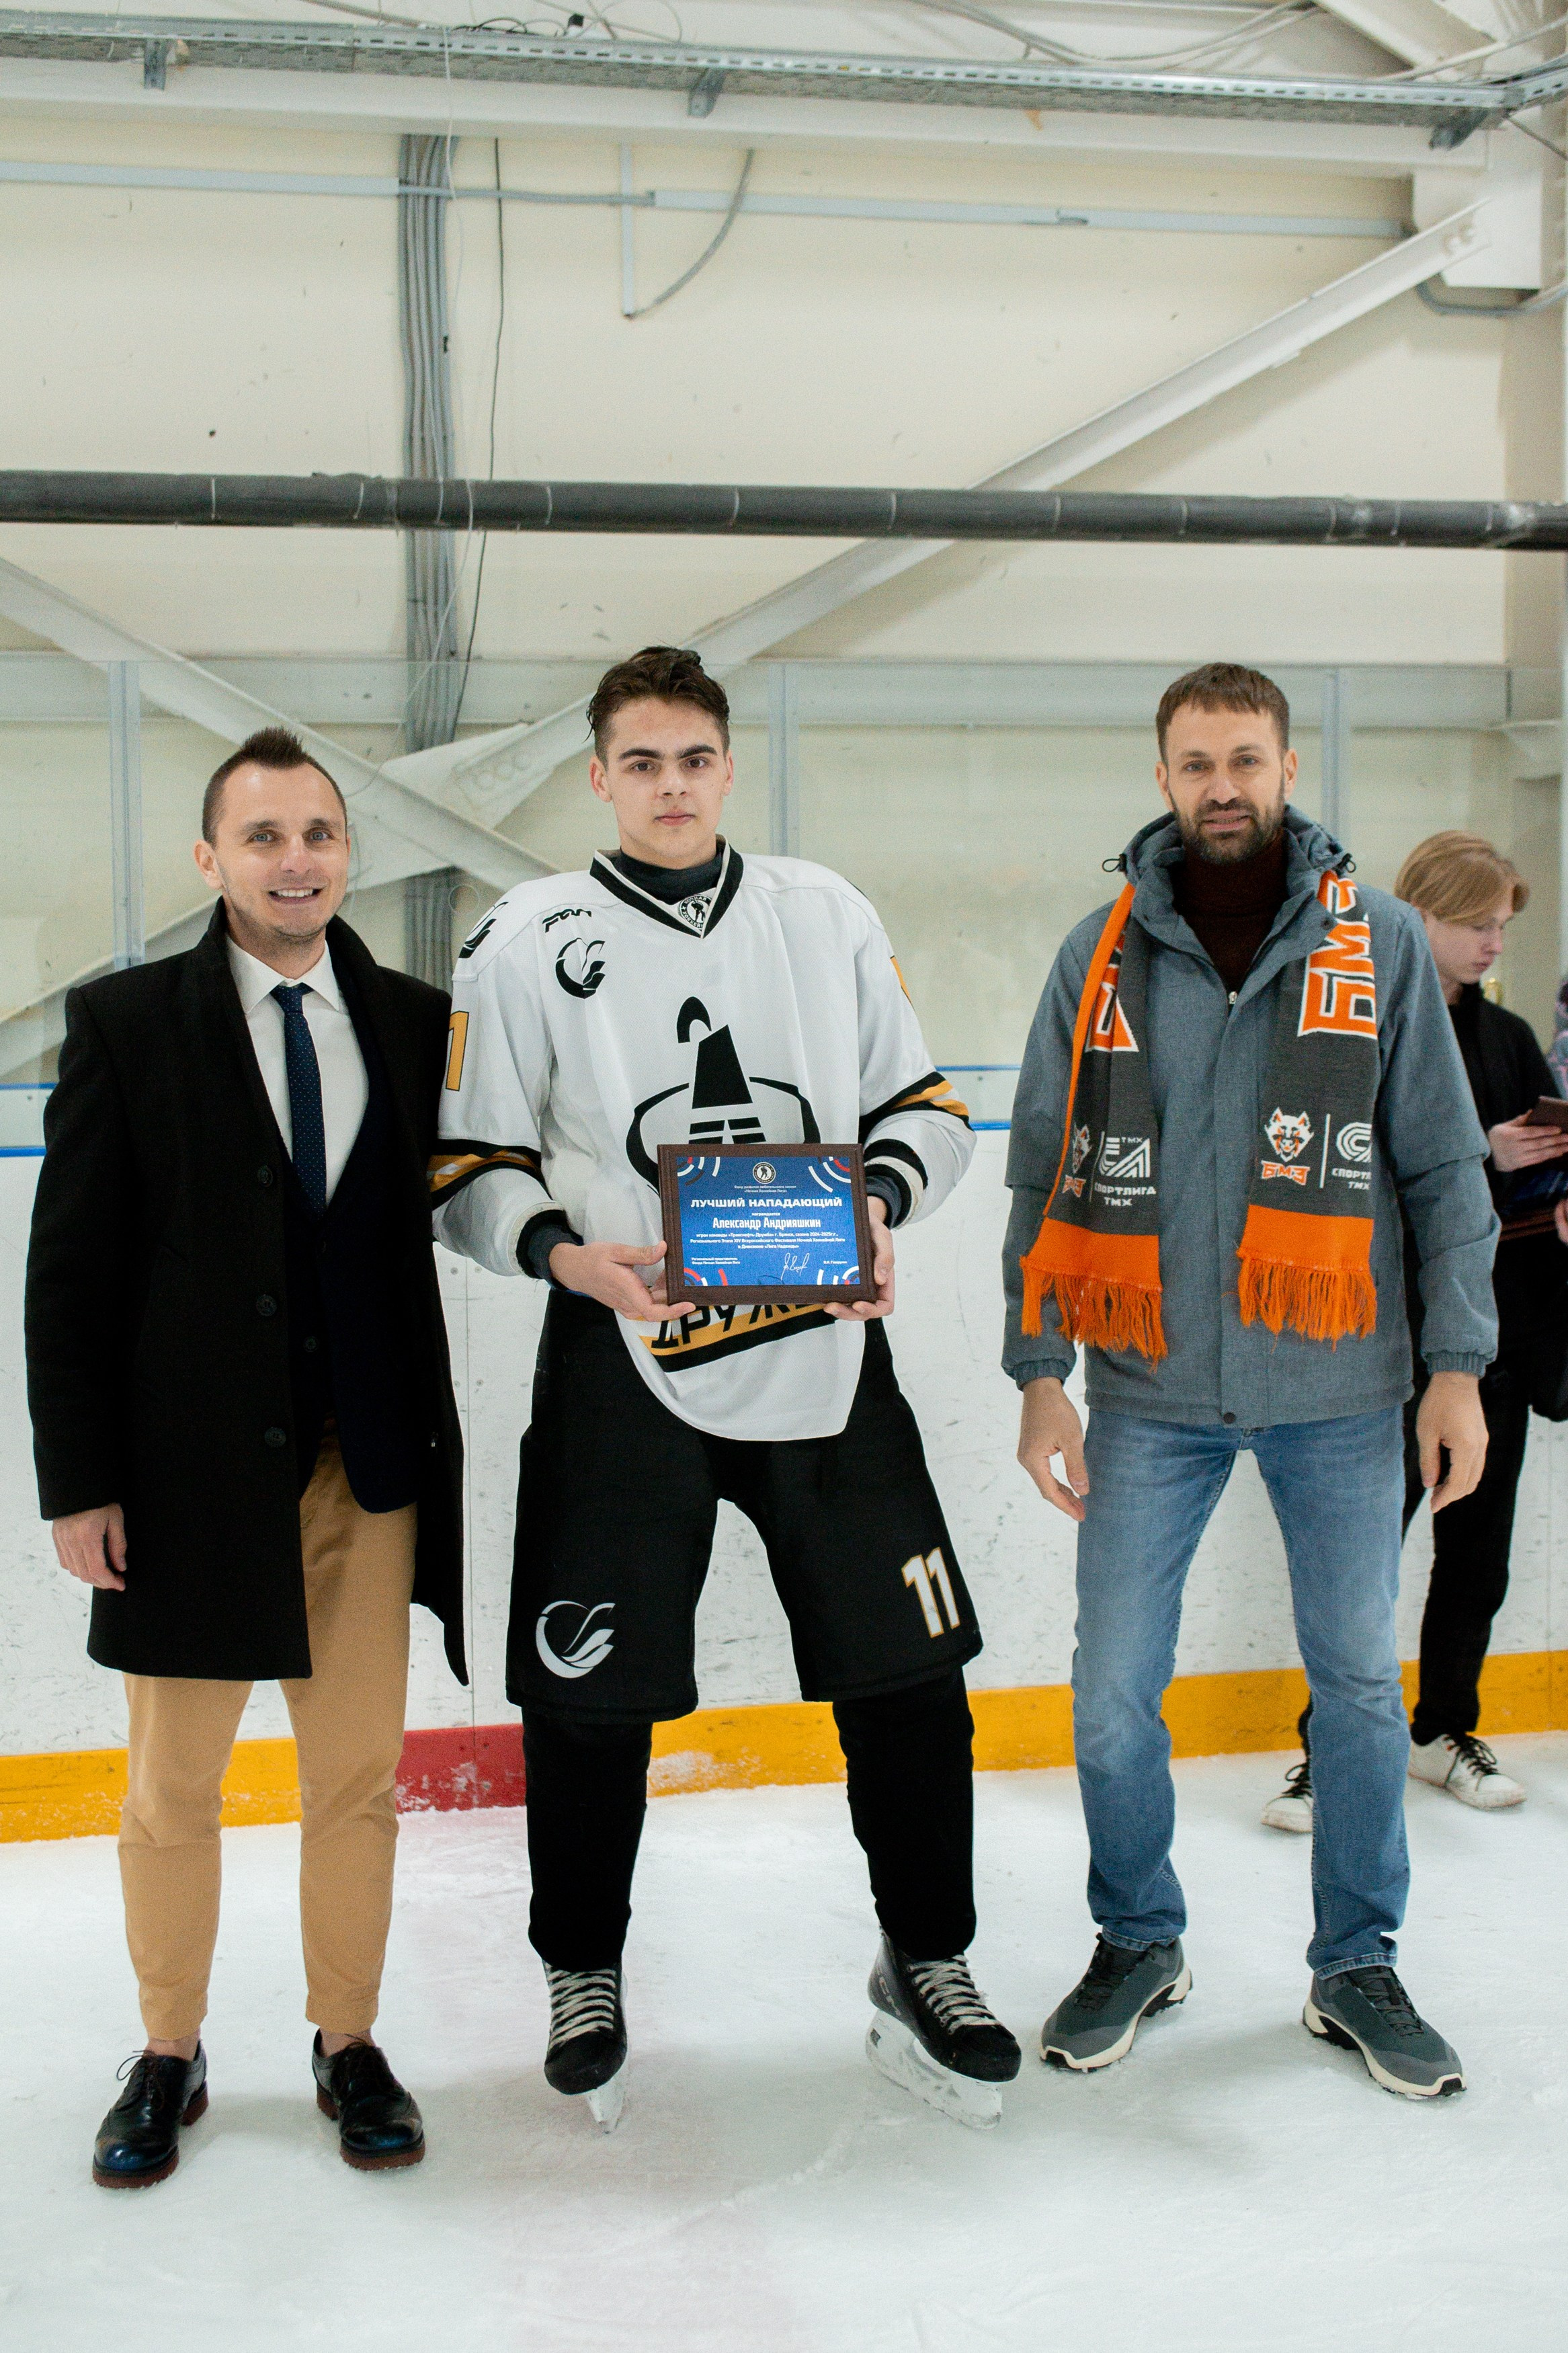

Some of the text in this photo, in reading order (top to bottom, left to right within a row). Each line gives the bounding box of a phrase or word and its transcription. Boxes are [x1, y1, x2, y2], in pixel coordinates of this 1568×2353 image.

[1261, 1160, 1311, 1186] БМЗ
[690, 1197, 842, 1208] ЛУЧШИЙ НАПАДАЮЩИЙ
[1104, 1197, 1132, 1207] ТМХ
[712, 1217, 821, 1230] Александр Андрияшкин
[902, 1547, 961, 1638] 11
